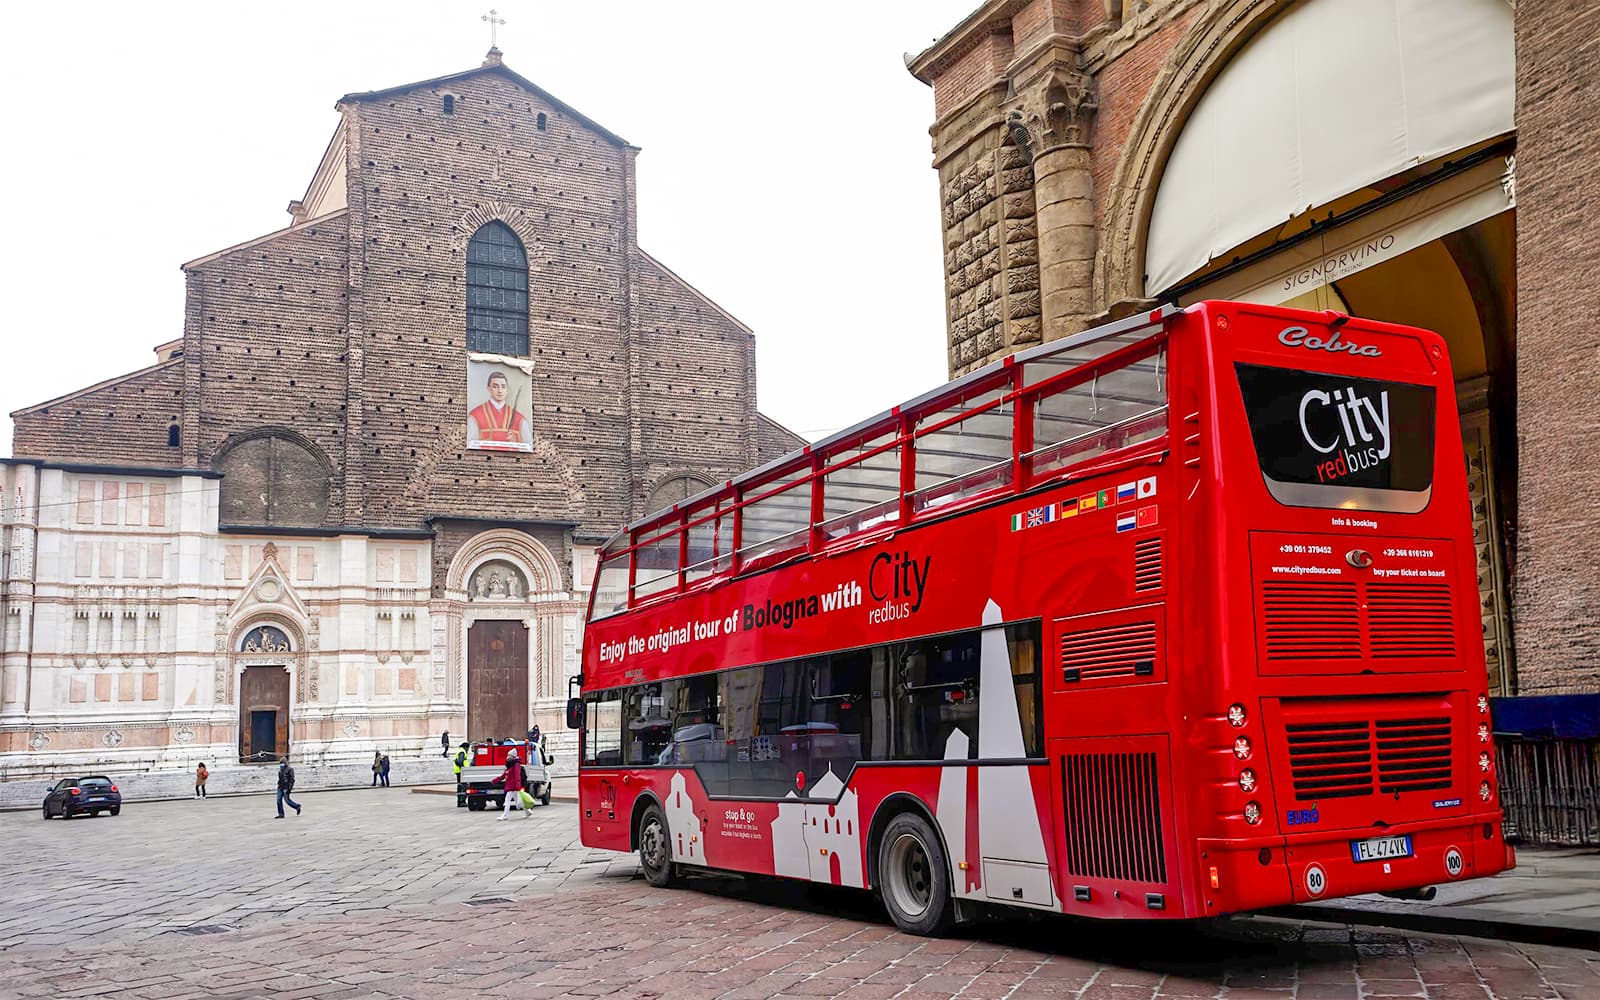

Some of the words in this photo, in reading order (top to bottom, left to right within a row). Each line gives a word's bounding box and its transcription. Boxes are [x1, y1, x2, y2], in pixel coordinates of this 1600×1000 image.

[1284, 234, 1395, 291] SIGNORVINO
[1278, 326, 1383, 357] Cobra
[1299, 386, 1391, 460] City
[1316, 448, 1379, 483] redbus
[1331, 517, 1345, 526] Info
[1352, 519, 1378, 529] booking
[1280, 544, 1293, 553] +39
[1294, 545, 1306, 553] 051
[1272, 565, 1342, 576] www.cityredbus.com
[1373, 567, 1385, 577] buy
[1386, 569, 1400, 578] your
[1401, 568, 1419, 577] ticket
[1428, 569, 1446, 577] board
[869, 550, 931, 613] City
[600, 640, 626, 664] Enjoy
[628, 635, 645, 655] the
[648, 621, 691, 653] original
[694, 619, 721, 641] tour
[724, 609, 739, 635] of
[743, 595, 819, 631] Bologna
[821, 580, 862, 612] with
[869, 600, 910, 625] redbus
[725, 810, 739, 822] stop
[739, 807, 746, 820] &
[746, 811, 756, 823] go
[1448, 855, 1461, 870] 100
[1310, 873, 1322, 888] 80
